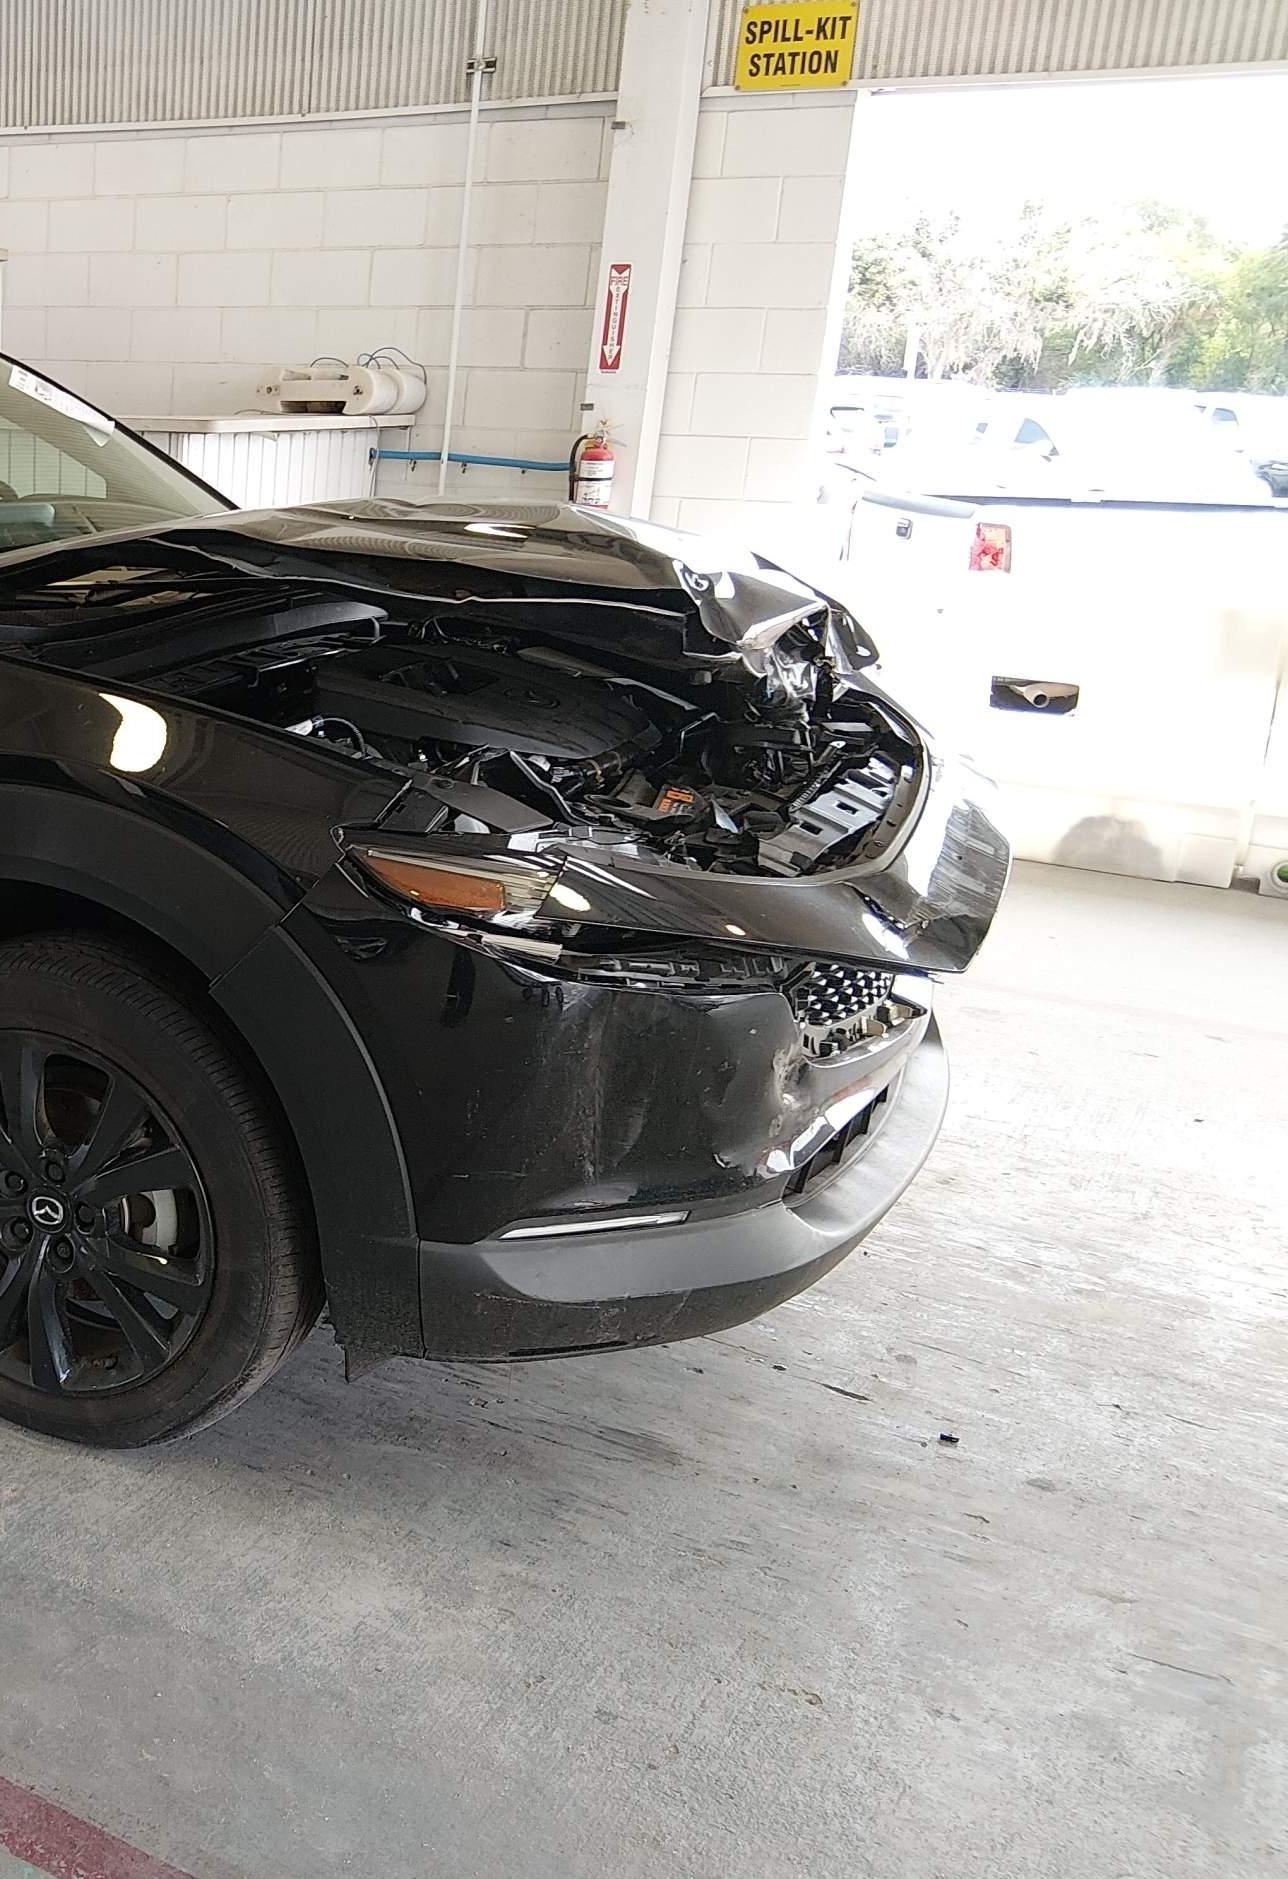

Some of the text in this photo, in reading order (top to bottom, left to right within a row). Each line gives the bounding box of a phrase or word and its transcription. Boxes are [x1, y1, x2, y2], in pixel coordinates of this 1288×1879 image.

[745, 16, 852, 45] SPILL-KIT
[748, 50, 840, 77] STATION
[609, 275, 630, 286] FIRE
